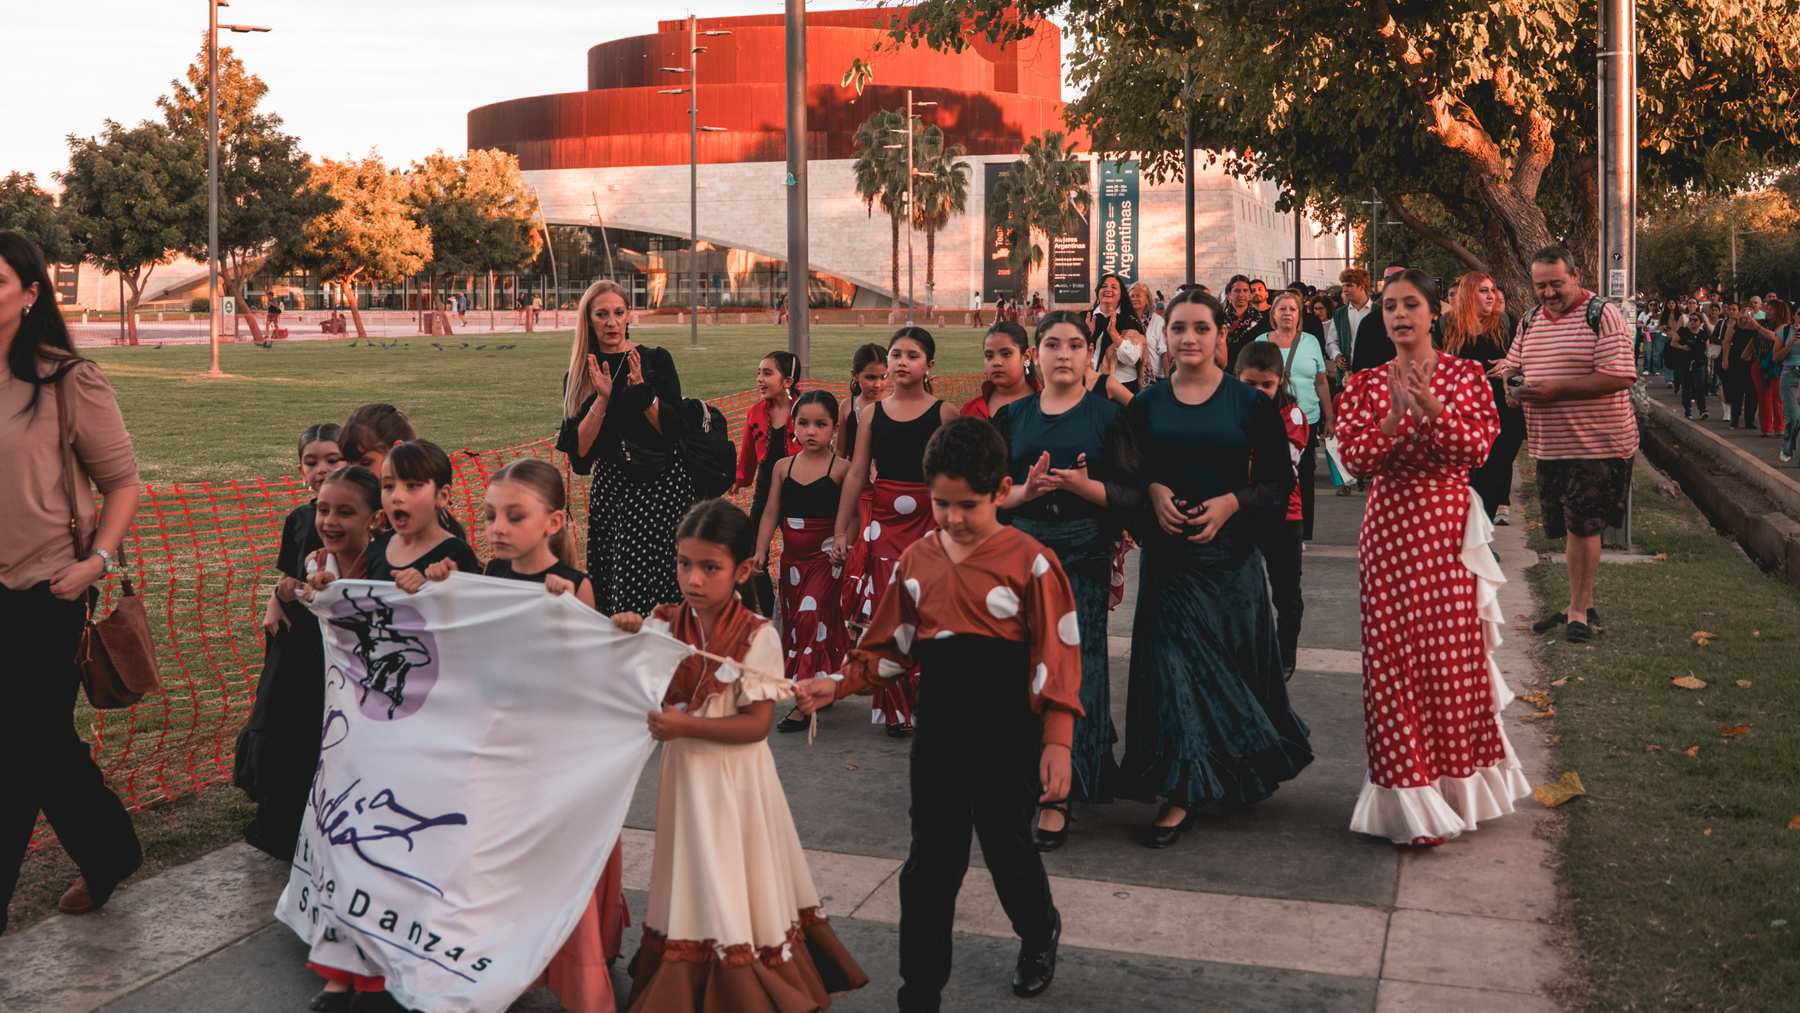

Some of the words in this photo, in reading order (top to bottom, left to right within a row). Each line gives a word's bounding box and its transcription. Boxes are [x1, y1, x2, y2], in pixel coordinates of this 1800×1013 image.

[1103, 220, 1118, 276] Mujeres
[1118, 200, 1134, 279] Argentinas
[347, 888, 492, 972] Danzas
